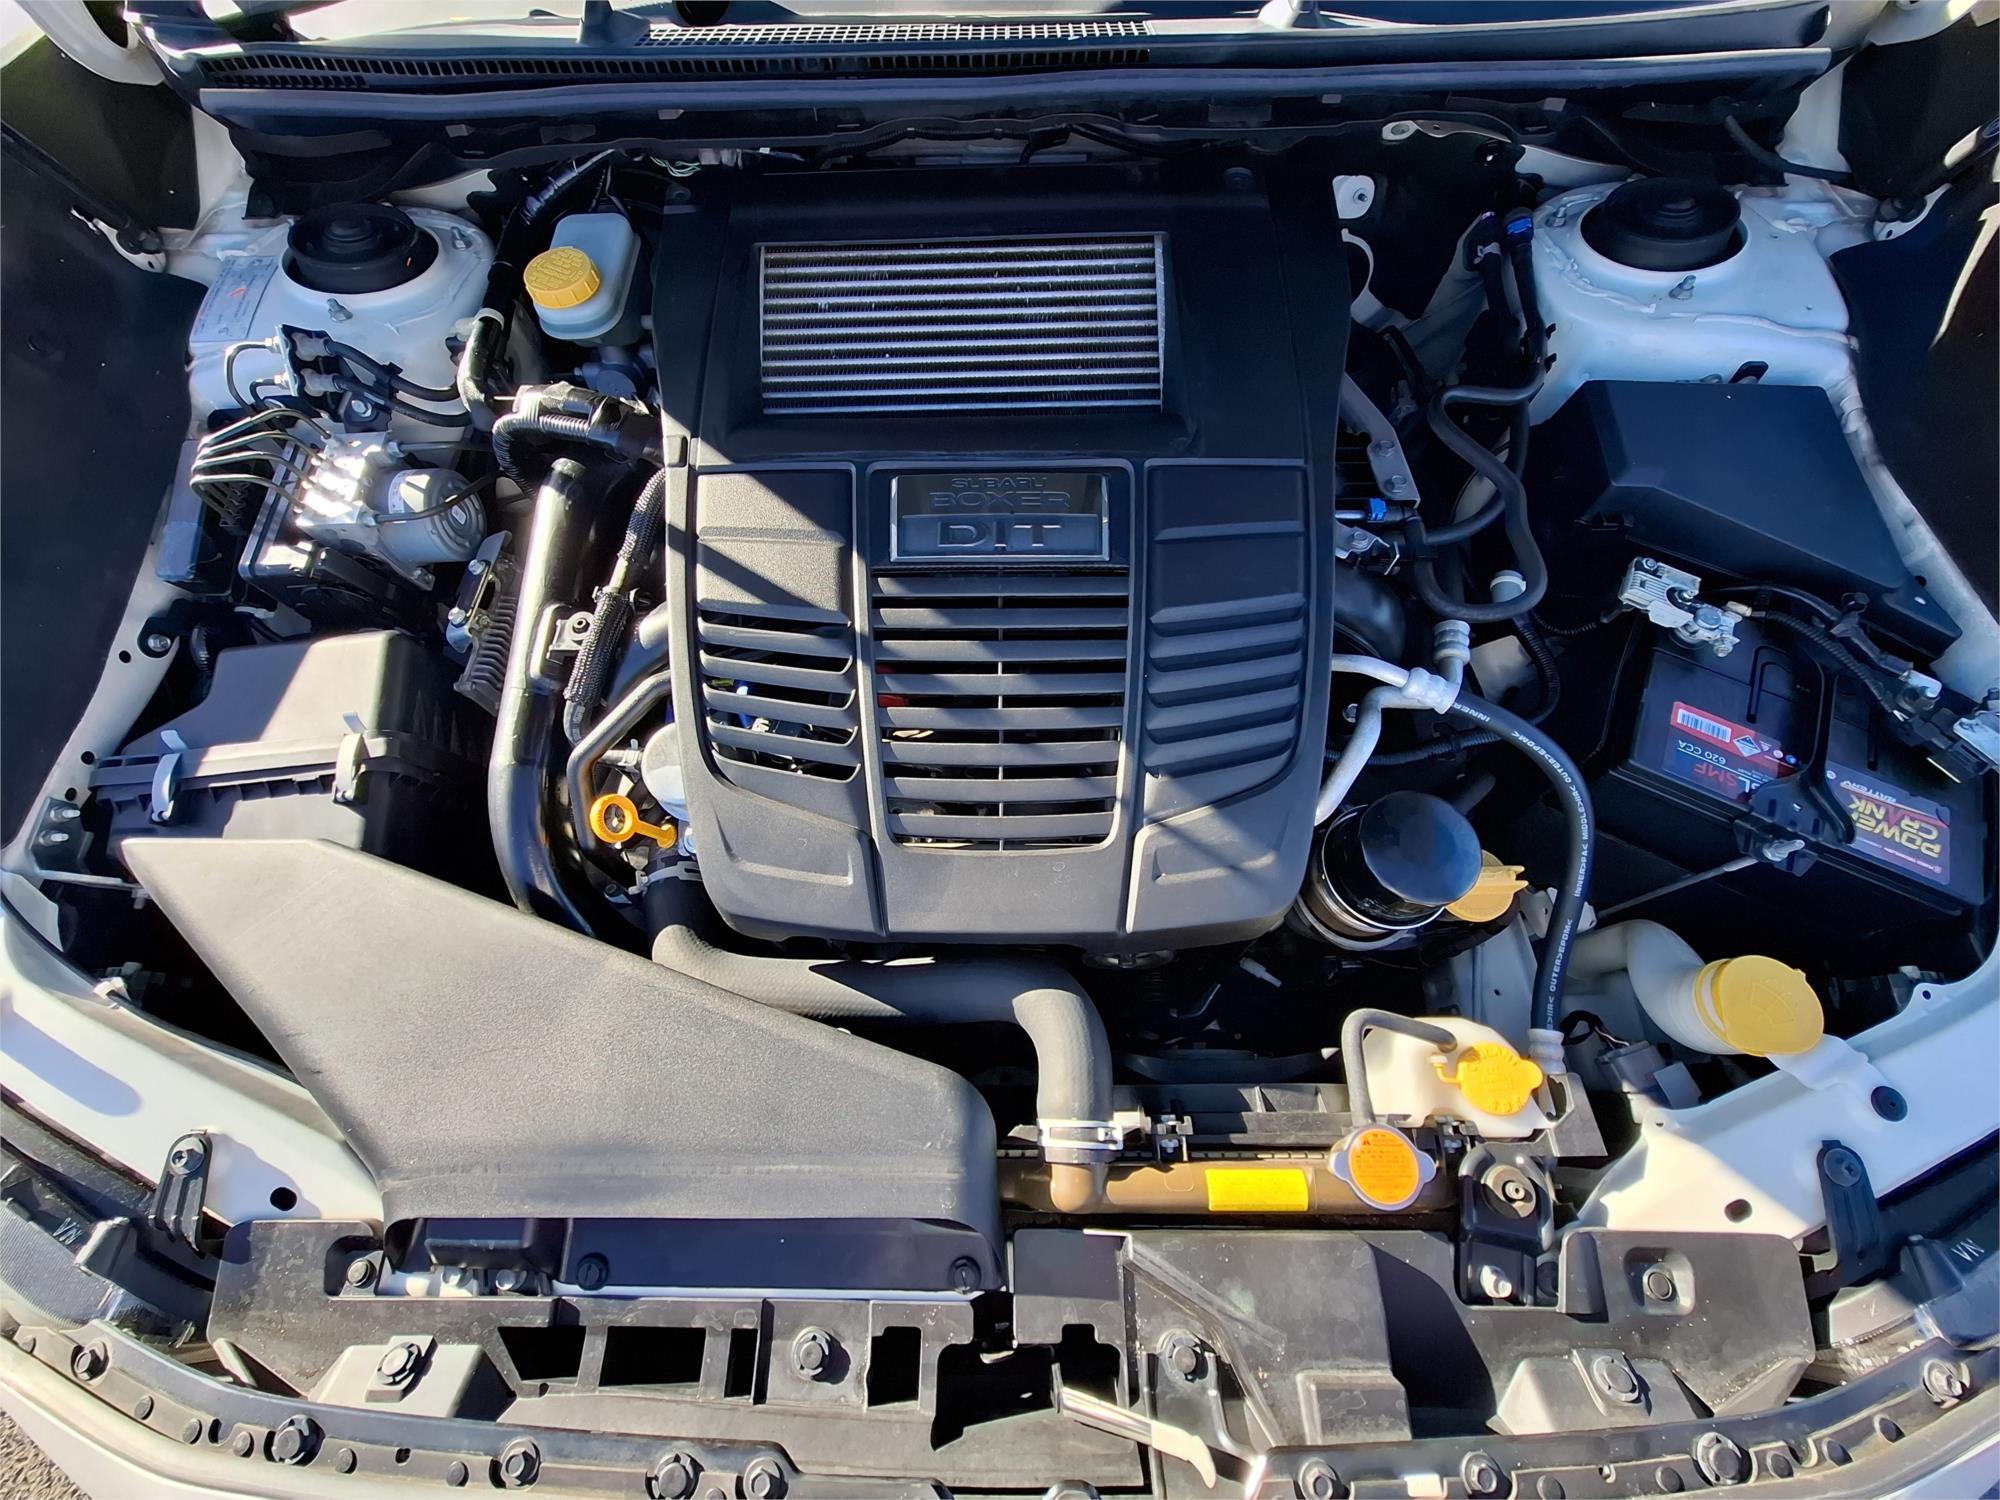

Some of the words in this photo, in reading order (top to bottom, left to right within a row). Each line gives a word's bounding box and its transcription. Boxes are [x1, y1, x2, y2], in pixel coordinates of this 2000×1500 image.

[951, 477, 1048, 488] SUBARU
[929, 491, 1071, 508] BOXER
[937, 521, 1062, 548] DIT
[1678, 739, 1702, 755] CCA
[1704, 750, 1727, 766] 620
[1848, 794, 1939, 841] CRANK
